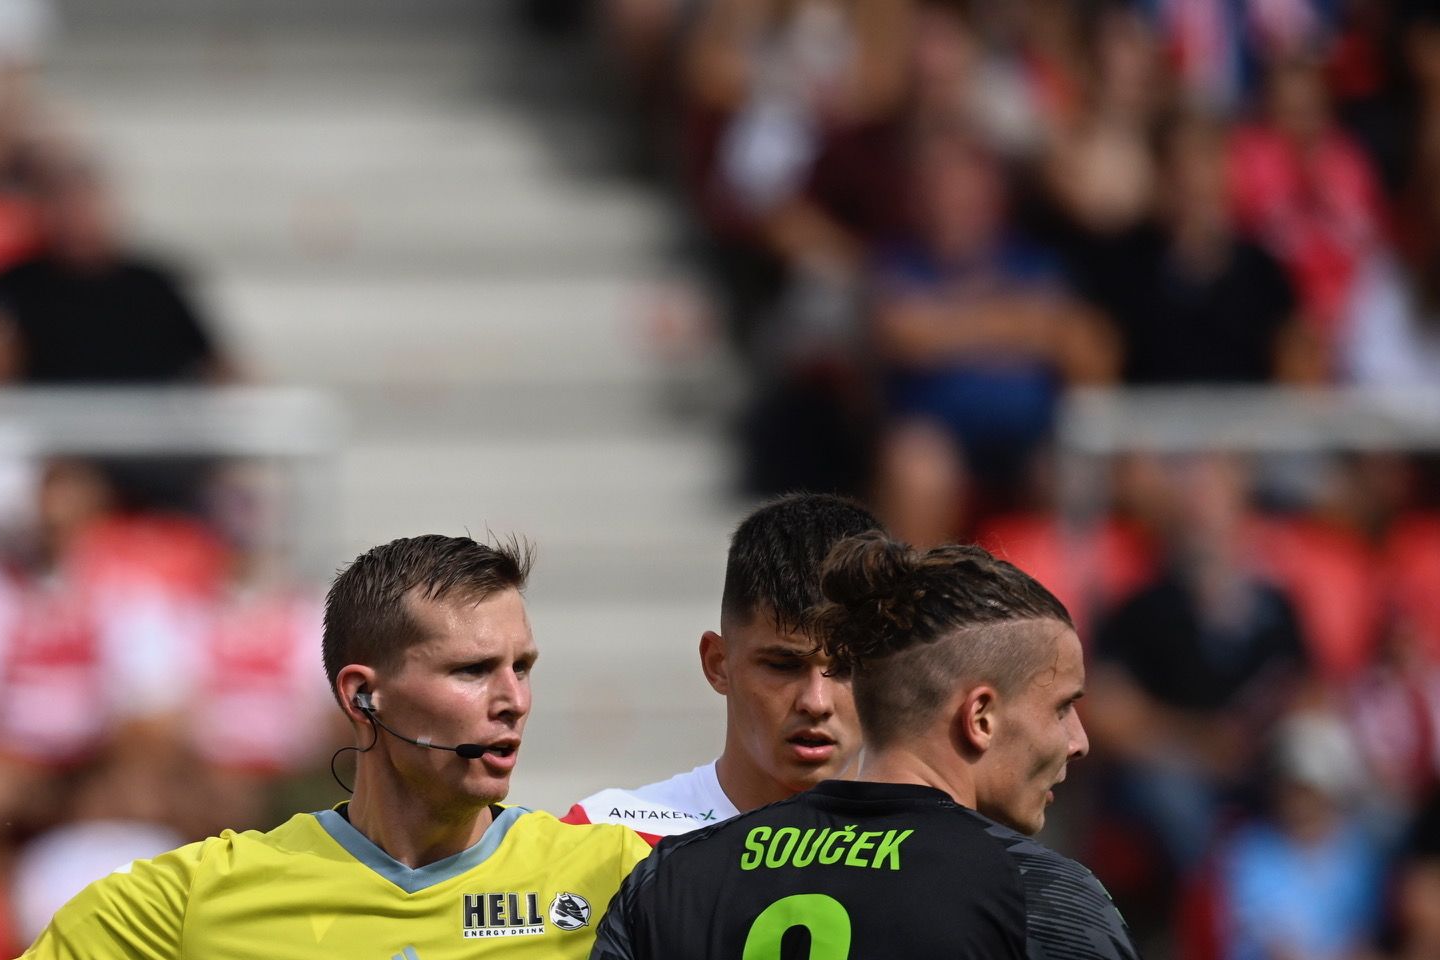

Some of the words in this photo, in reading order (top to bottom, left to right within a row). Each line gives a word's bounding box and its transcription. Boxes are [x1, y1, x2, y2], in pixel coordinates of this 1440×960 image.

[740, 823, 916, 870] SOUČEK
[463, 893, 544, 928] HELL
[464, 928, 506, 937] ENERGY
[511, 927, 545, 935] DRINK
